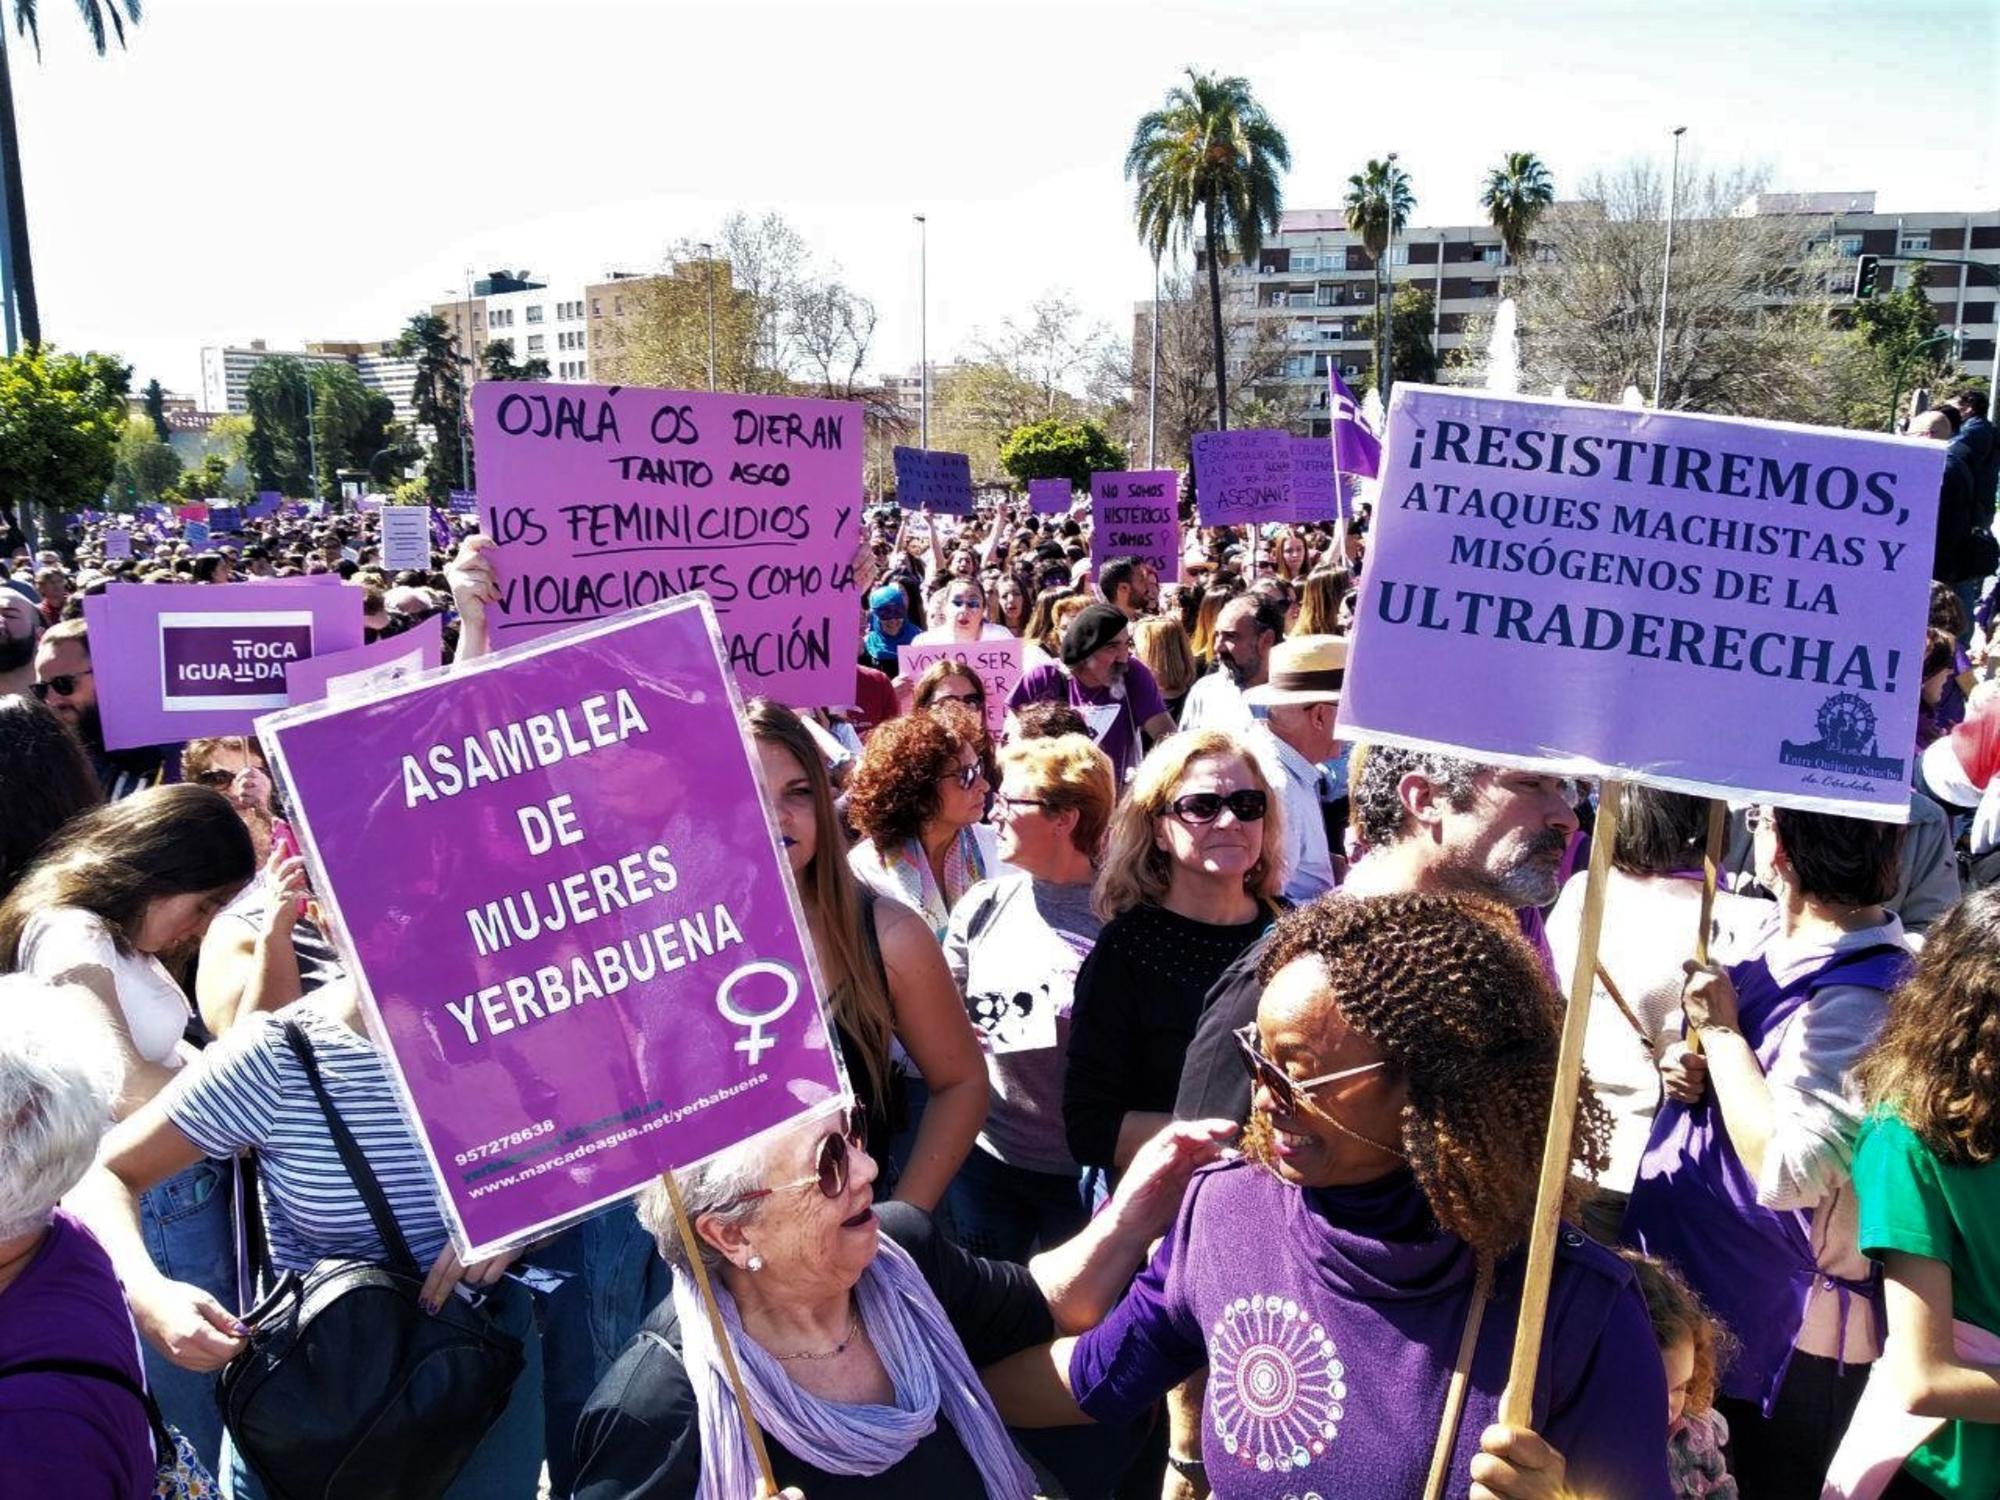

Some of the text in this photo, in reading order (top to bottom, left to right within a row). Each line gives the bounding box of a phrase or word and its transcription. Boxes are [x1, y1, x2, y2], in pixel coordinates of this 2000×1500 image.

[497, 385, 843, 450] OJALÁ OS DIERAN
[608, 455, 790, 488] TANTO ASCO
[1101, 483, 1165, 498] NO SOMOS
[1408, 419, 1911, 526] ¡RESISTIREMOS,
[490, 502, 851, 547] LOS FEMINICIDIOS Y
[1109, 531, 1154, 547] SOMOS
[1401, 481, 1908, 572] ATAQUES MACHISTAS Y
[748, 563, 822, 600] COMO
[830, 562, 856, 593] LA
[1449, 533, 1840, 616] MISÓGENOS DE LA
[974, 651, 1018, 670] SER
[1377, 580, 1902, 694] ULTRADERECHA!
[178, 662, 285, 682] IGUALDA
[400, 688, 650, 809] ASAMBLEA
[516, 793, 585, 856] DE
[465, 843, 679, 957] MUJERES
[445, 903, 744, 1045] YERBABUENA
[454, 1118, 556, 1168] 957278638
[467, 1071, 770, 1200] www.marcadeagua.net/yerbabuena
